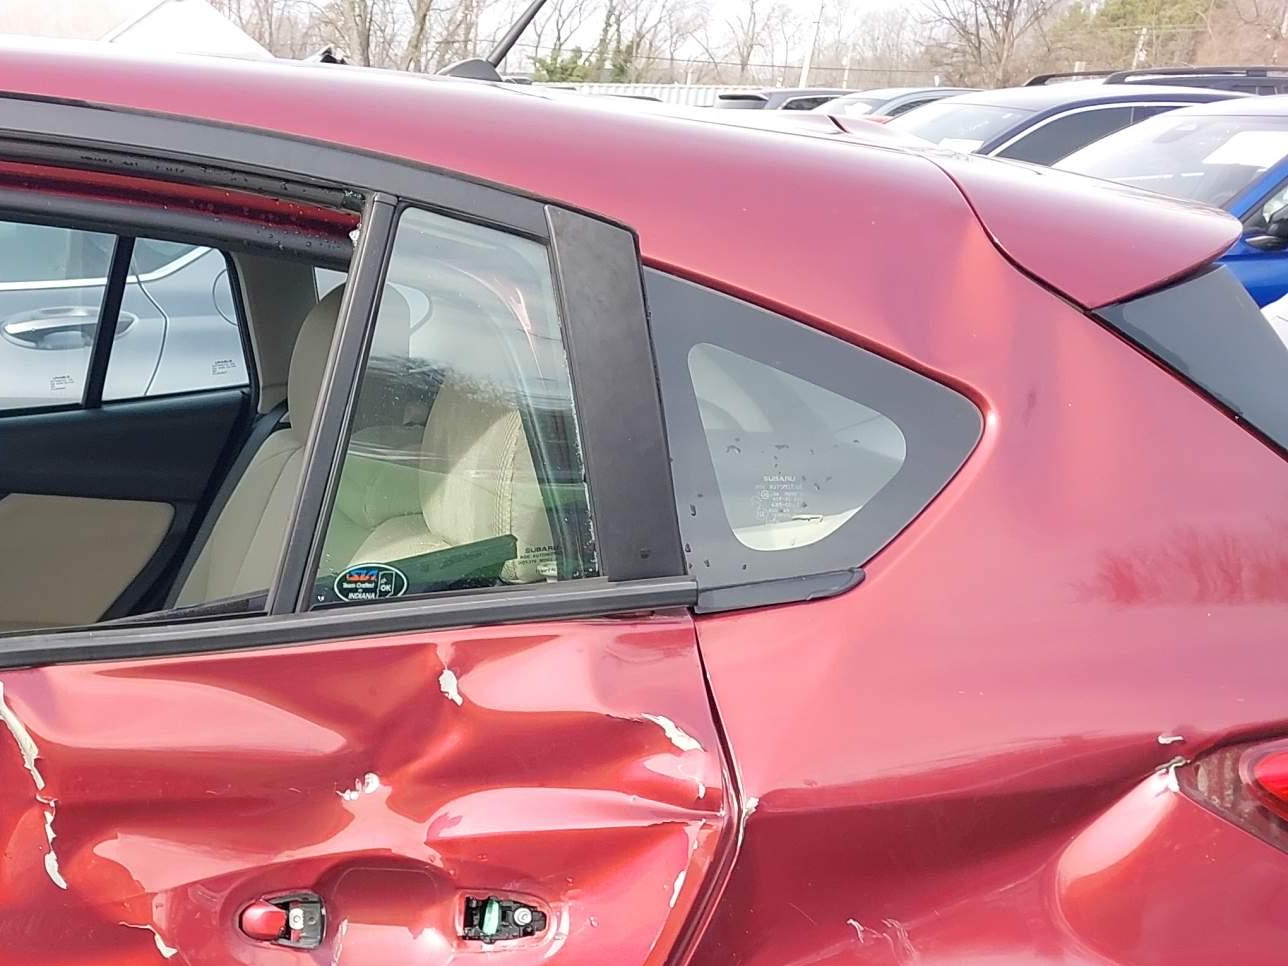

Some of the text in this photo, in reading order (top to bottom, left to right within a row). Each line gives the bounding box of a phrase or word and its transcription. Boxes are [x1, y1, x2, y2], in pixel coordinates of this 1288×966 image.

[525, 544, 560, 554] SUBARU
[380, 584, 392, 592] OK
[348, 592, 376, 600] INDIANA
